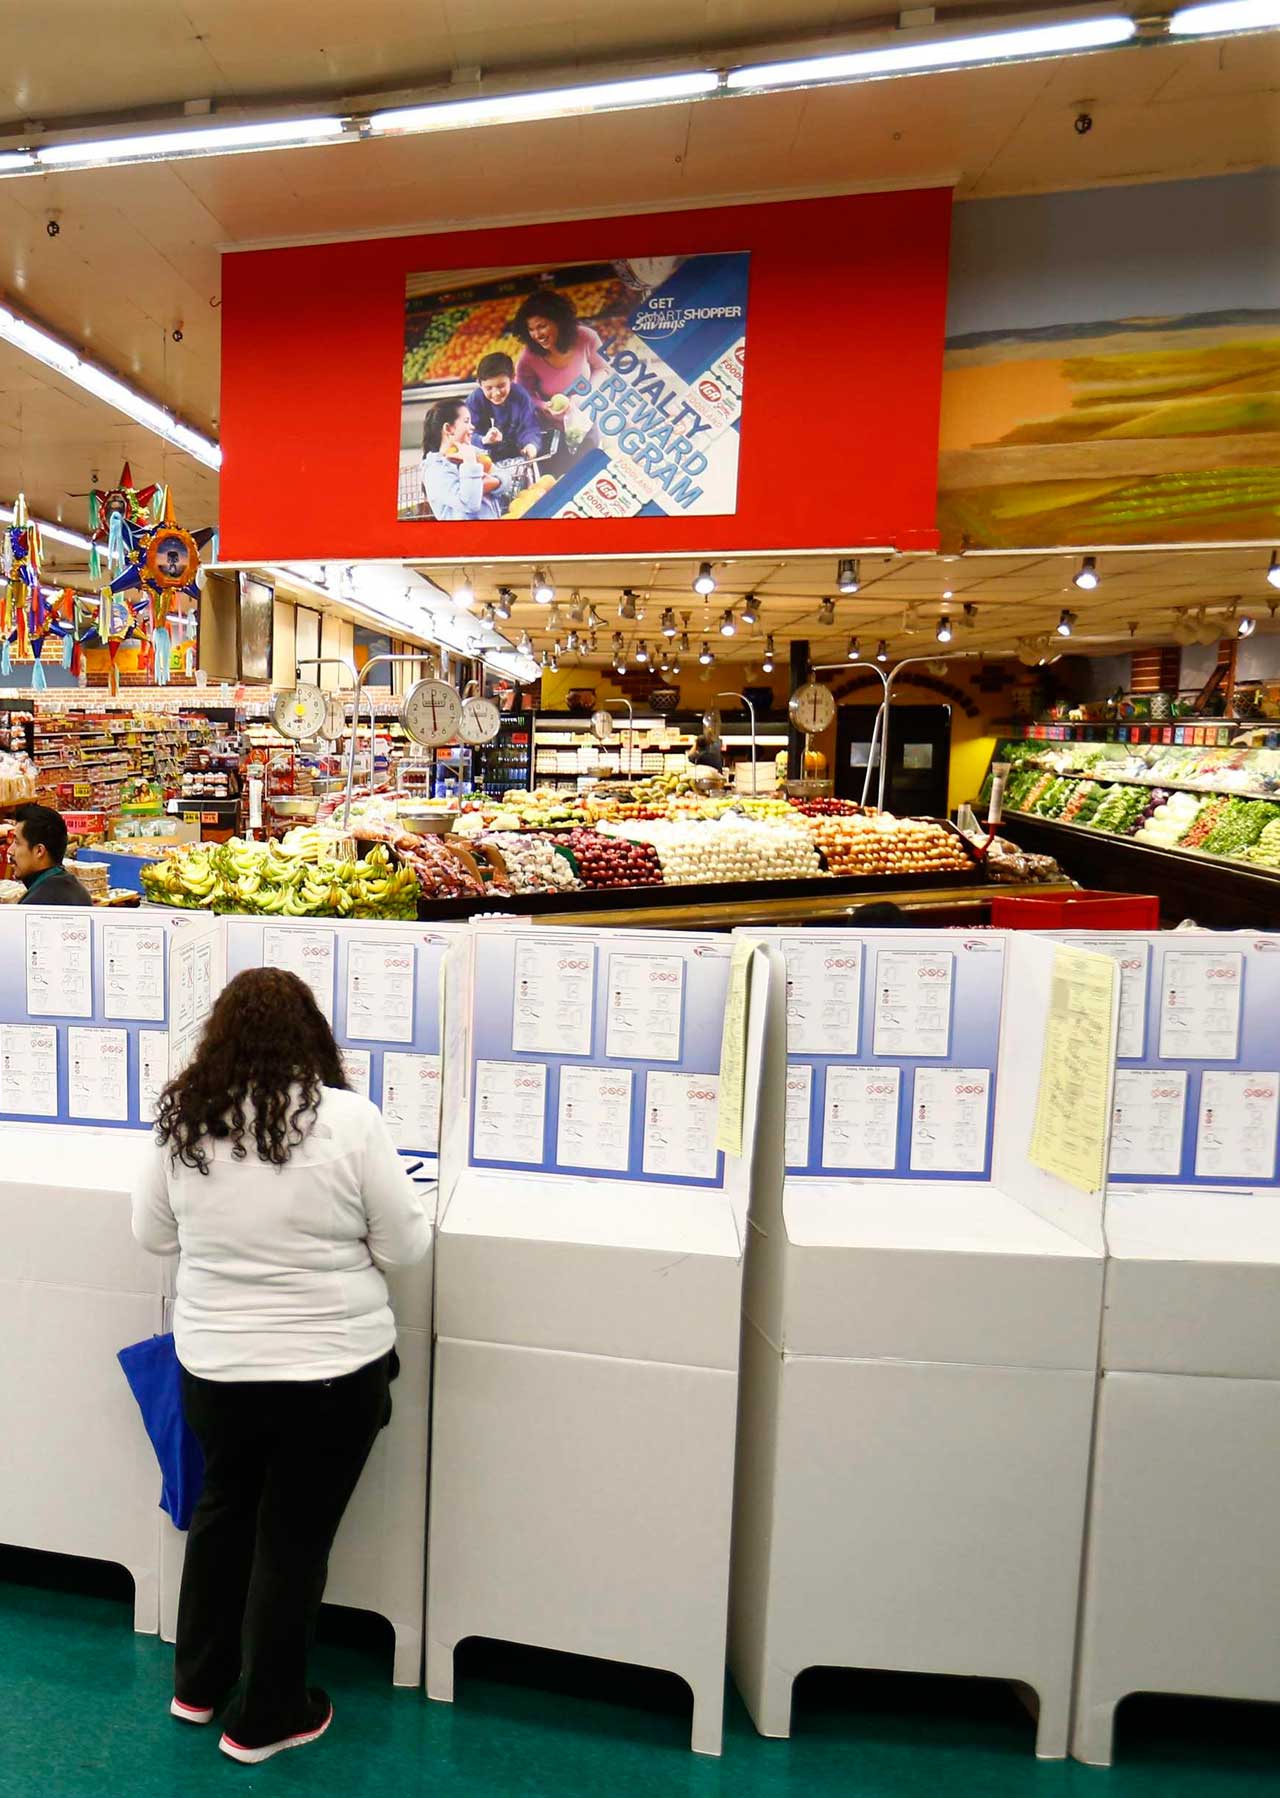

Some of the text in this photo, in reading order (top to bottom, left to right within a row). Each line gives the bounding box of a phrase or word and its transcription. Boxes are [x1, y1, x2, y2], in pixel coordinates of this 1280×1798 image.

[648, 298, 675, 309] GET
[683, 306, 742, 320] SHOPPER
[597, 336, 712, 440] LOYALTY
[700, 383, 721, 402] IGA
[599, 373, 709, 477] REWARD
[563, 373, 705, 510] PROGRAM
[596, 481, 616, 499] IGA
